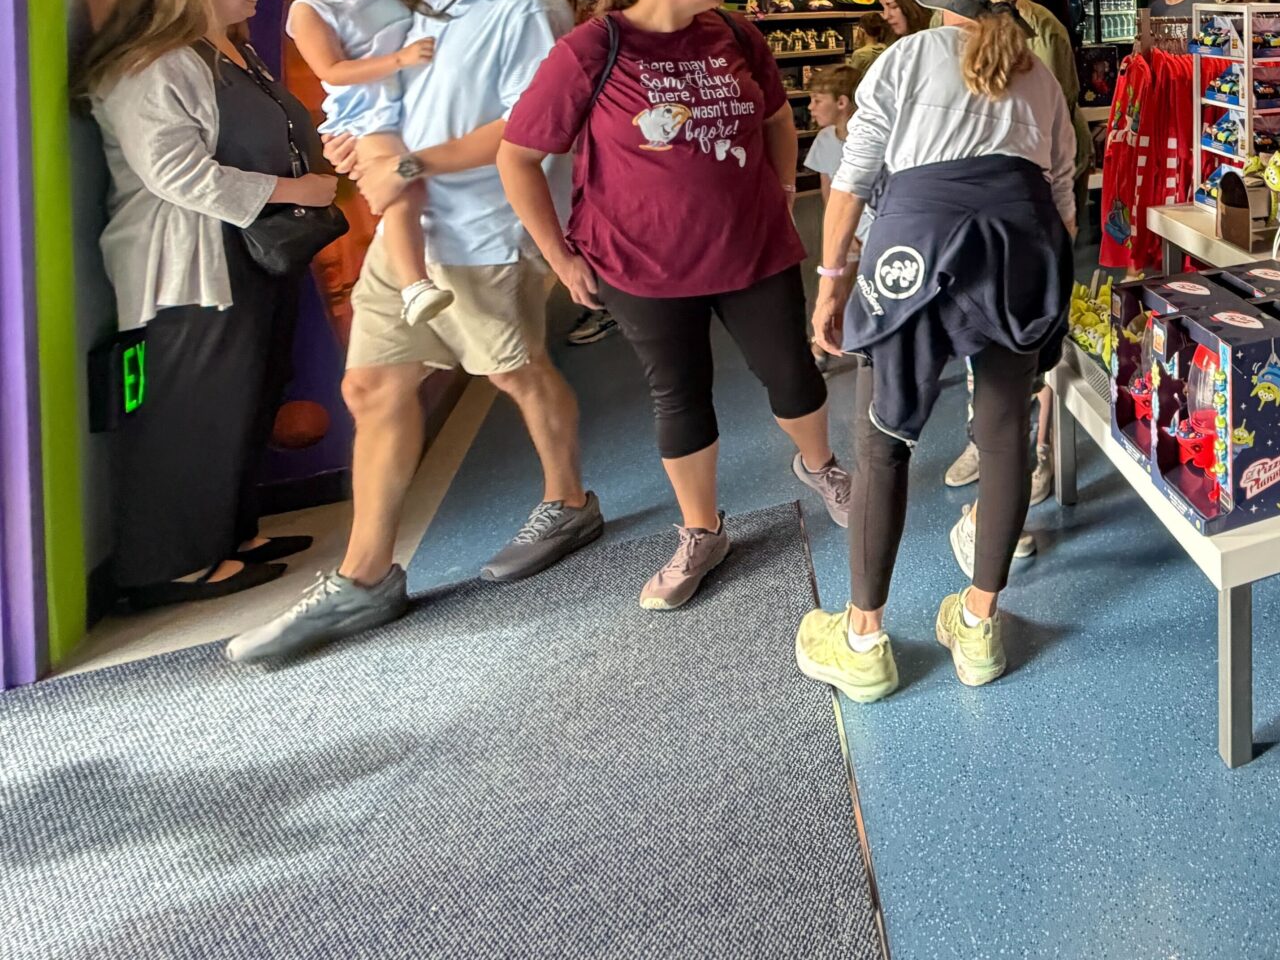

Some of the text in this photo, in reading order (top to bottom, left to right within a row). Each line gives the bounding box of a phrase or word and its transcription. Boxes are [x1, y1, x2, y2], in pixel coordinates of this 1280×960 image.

[678, 60, 706, 72] may
[708, 56, 729, 69] be
[647, 86, 732, 103] there, that
[691, 99, 755, 119] wasn't there
[685, 119, 740, 154] before!
